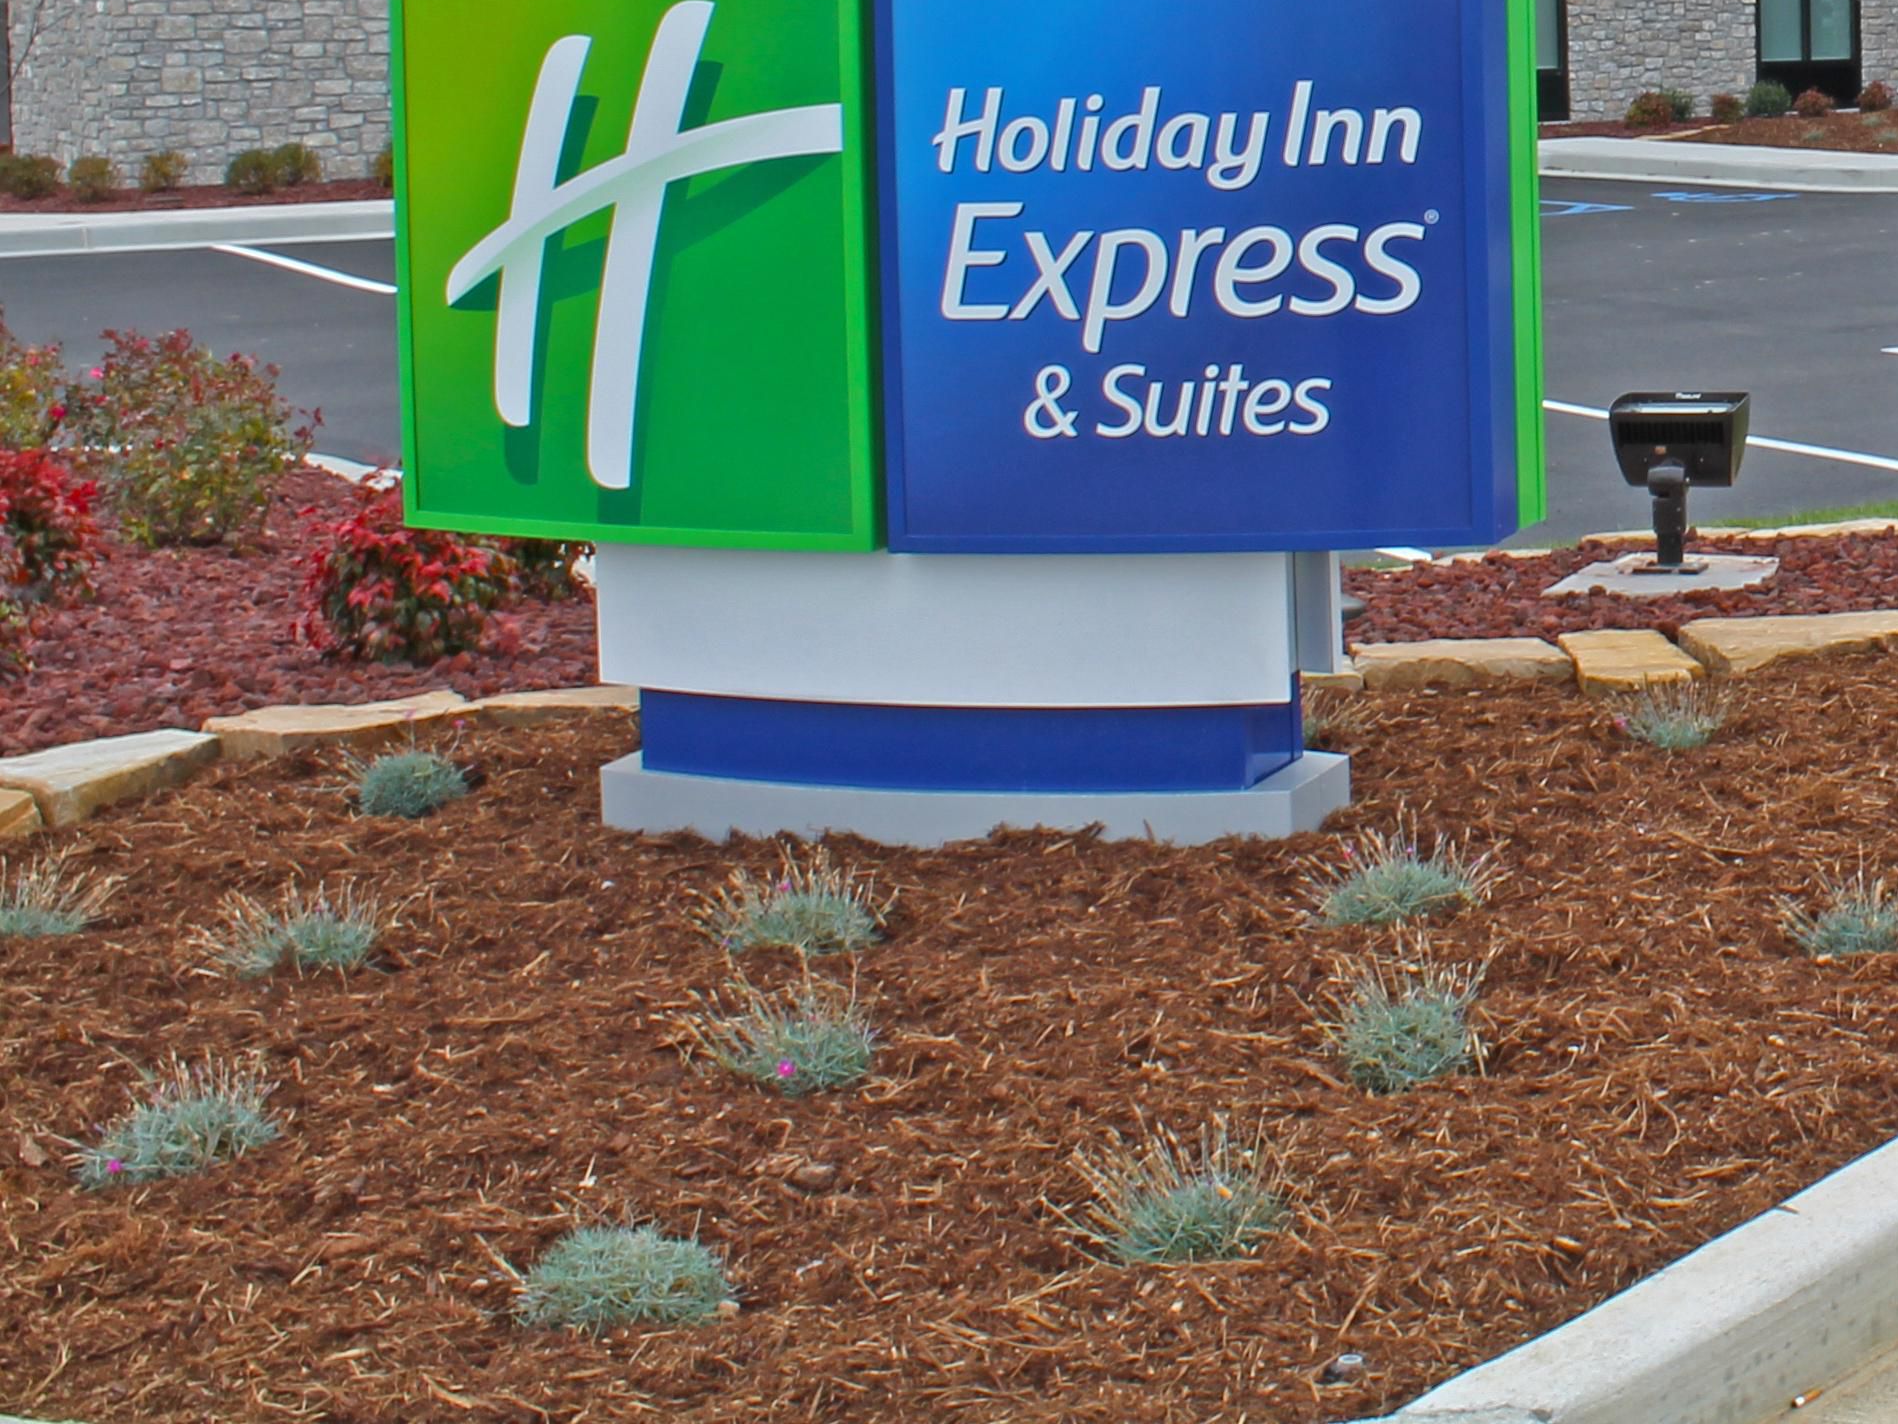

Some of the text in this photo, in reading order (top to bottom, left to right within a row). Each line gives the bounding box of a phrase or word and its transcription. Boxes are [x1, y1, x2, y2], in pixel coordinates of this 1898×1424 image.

[931, 79, 1423, 191] Holiday Inn
[1022, 363, 1333, 439] & Suites
